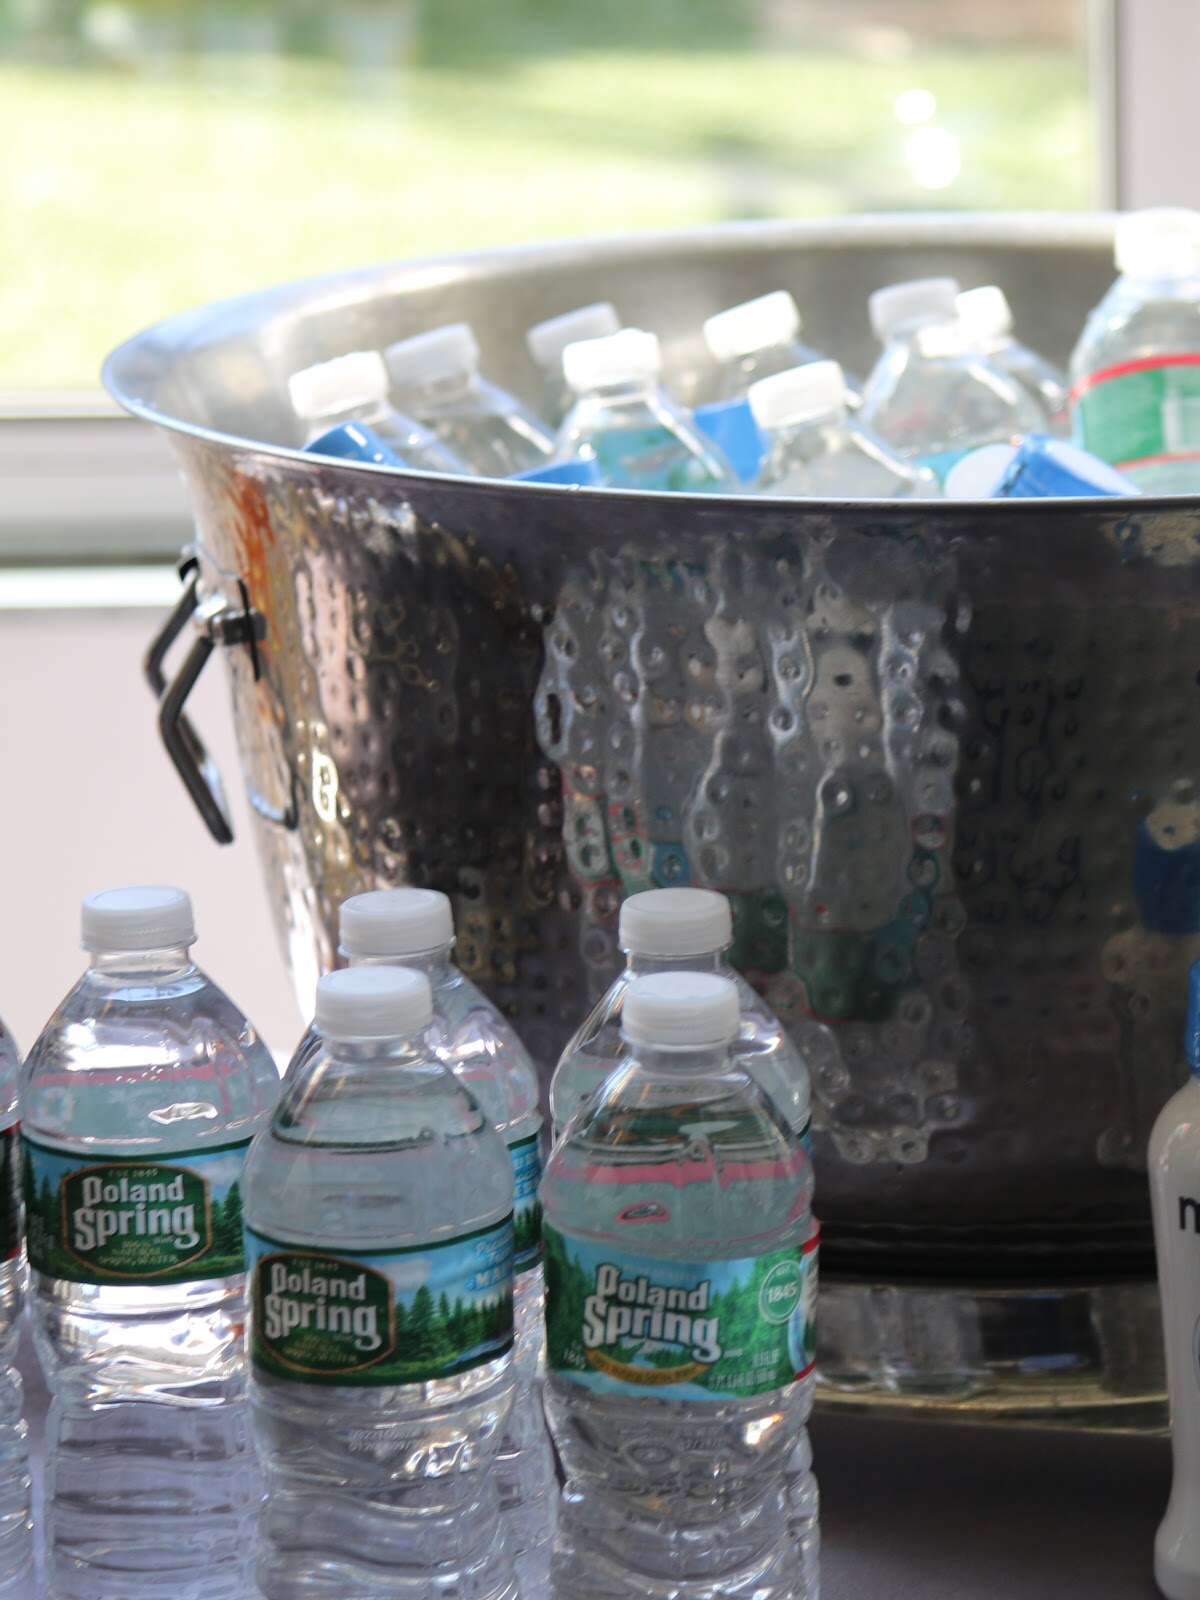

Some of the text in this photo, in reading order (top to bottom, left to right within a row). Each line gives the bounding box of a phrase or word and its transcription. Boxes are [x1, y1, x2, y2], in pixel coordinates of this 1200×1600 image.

[82, 1174, 185, 1207] Poland
[73, 1202, 201, 1251] Spring
[270, 1262, 367, 1301] Poland
[597, 1263, 711, 1312] Poland
[767, 1281, 799, 1304] 1845
[264, 1293, 383, 1351] Spring
[582, 1294, 722, 1363] Spring
